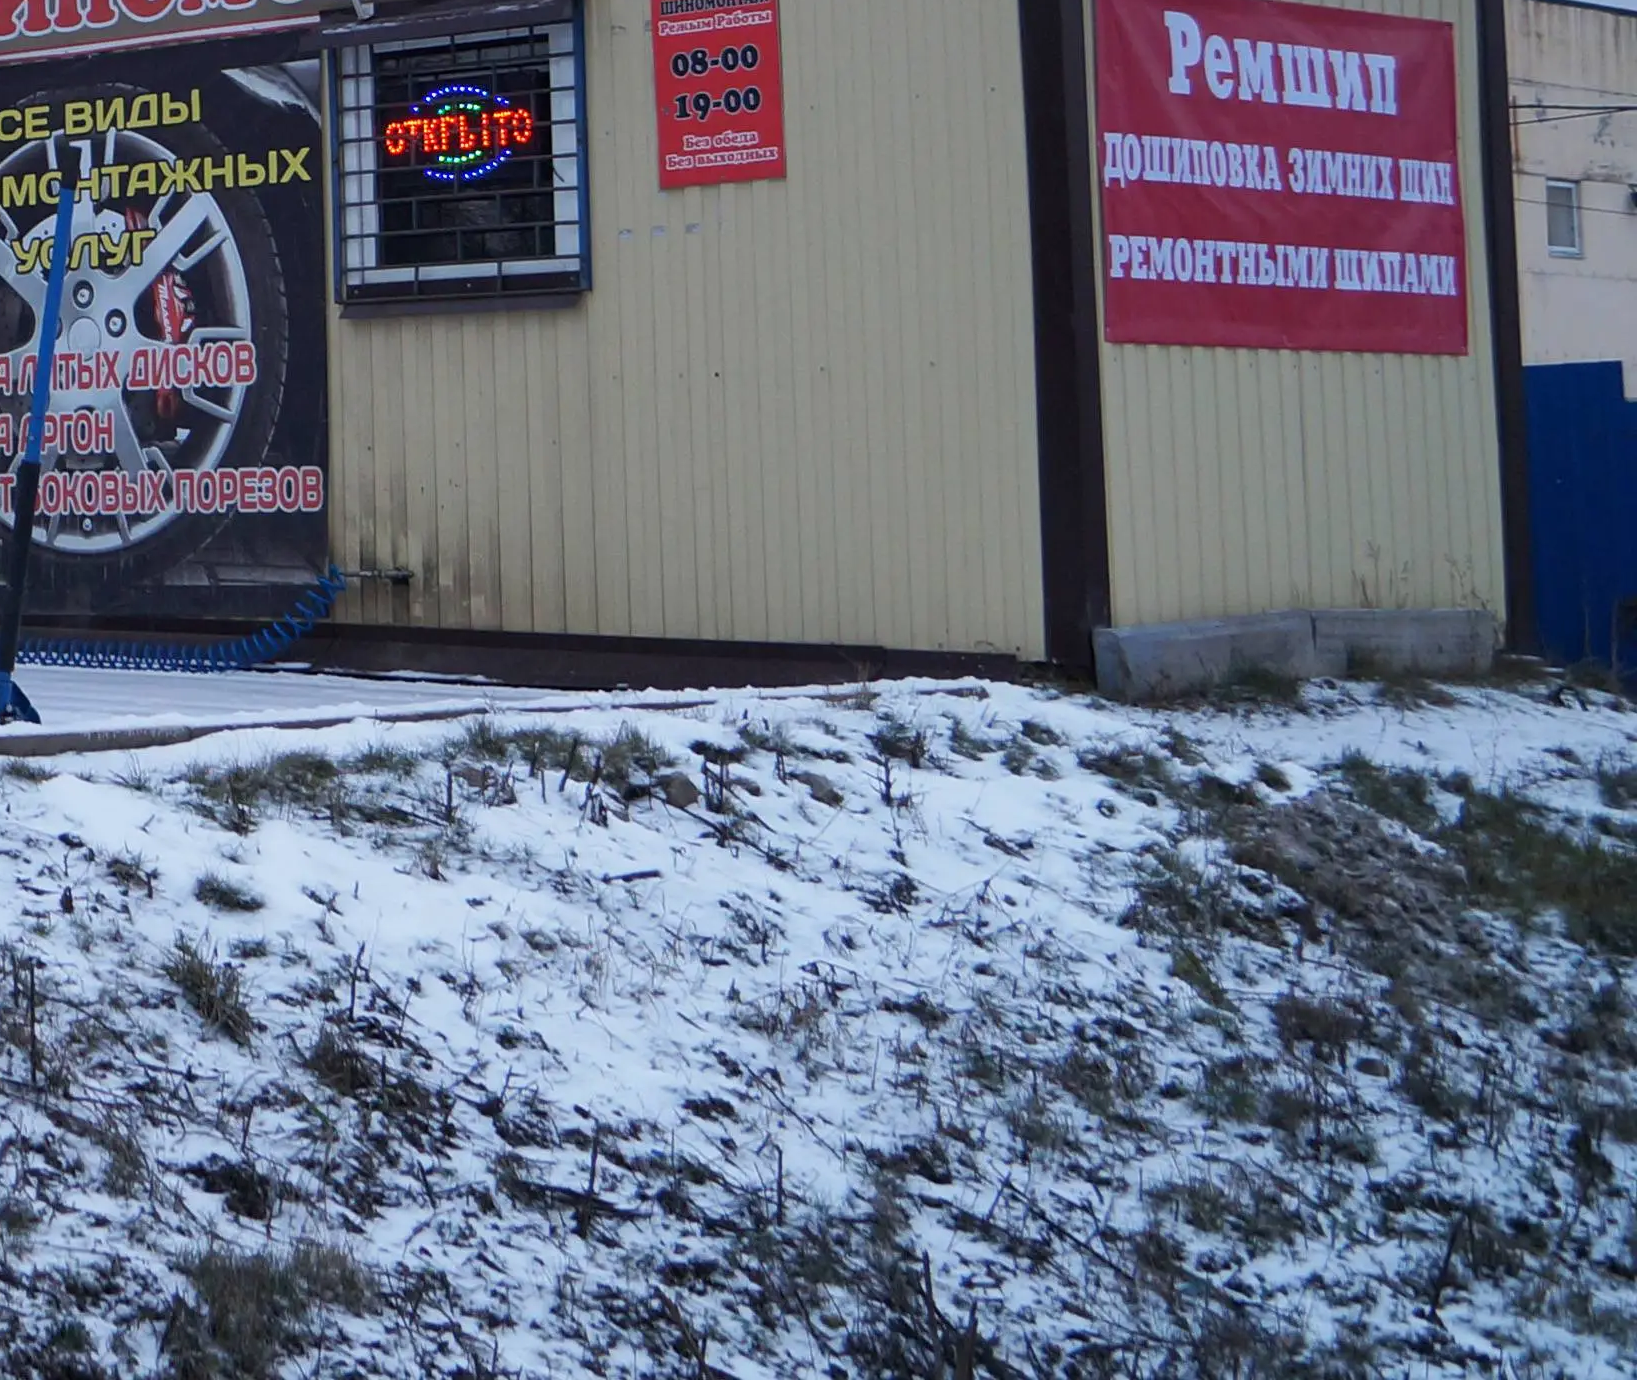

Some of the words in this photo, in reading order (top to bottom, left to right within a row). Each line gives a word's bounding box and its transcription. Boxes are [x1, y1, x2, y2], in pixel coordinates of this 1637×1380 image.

[713, 10, 772, 29] Работы
[671, 43, 759, 78] 08-00
[1163, 10, 1398, 115] Ремшип
[63, 89, 202, 136] ВИДЫ
[674, 86, 762, 121] 19-00
[666, 153, 694, 170] Без
[695, 147, 778, 167] выходных
[683, 133, 711, 150] Без
[713, 130, 759, 148] обеда
[1104, 131, 1282, 191] ДОШИПОВКА
[1288, 147, 1395, 200] ЗИМНИХ
[1399, 158, 1455, 205] ШИН
[1108, 234, 1329, 289] РЕМОНТНЫМИ
[1334, 249, 1458, 296] ШИПАМИ
[126, 341, 257, 390] ДИСКОВ
[31, 469, 168, 516] ОКОВЫХ
[172, 465, 325, 513] ПОРЕЗОВ
